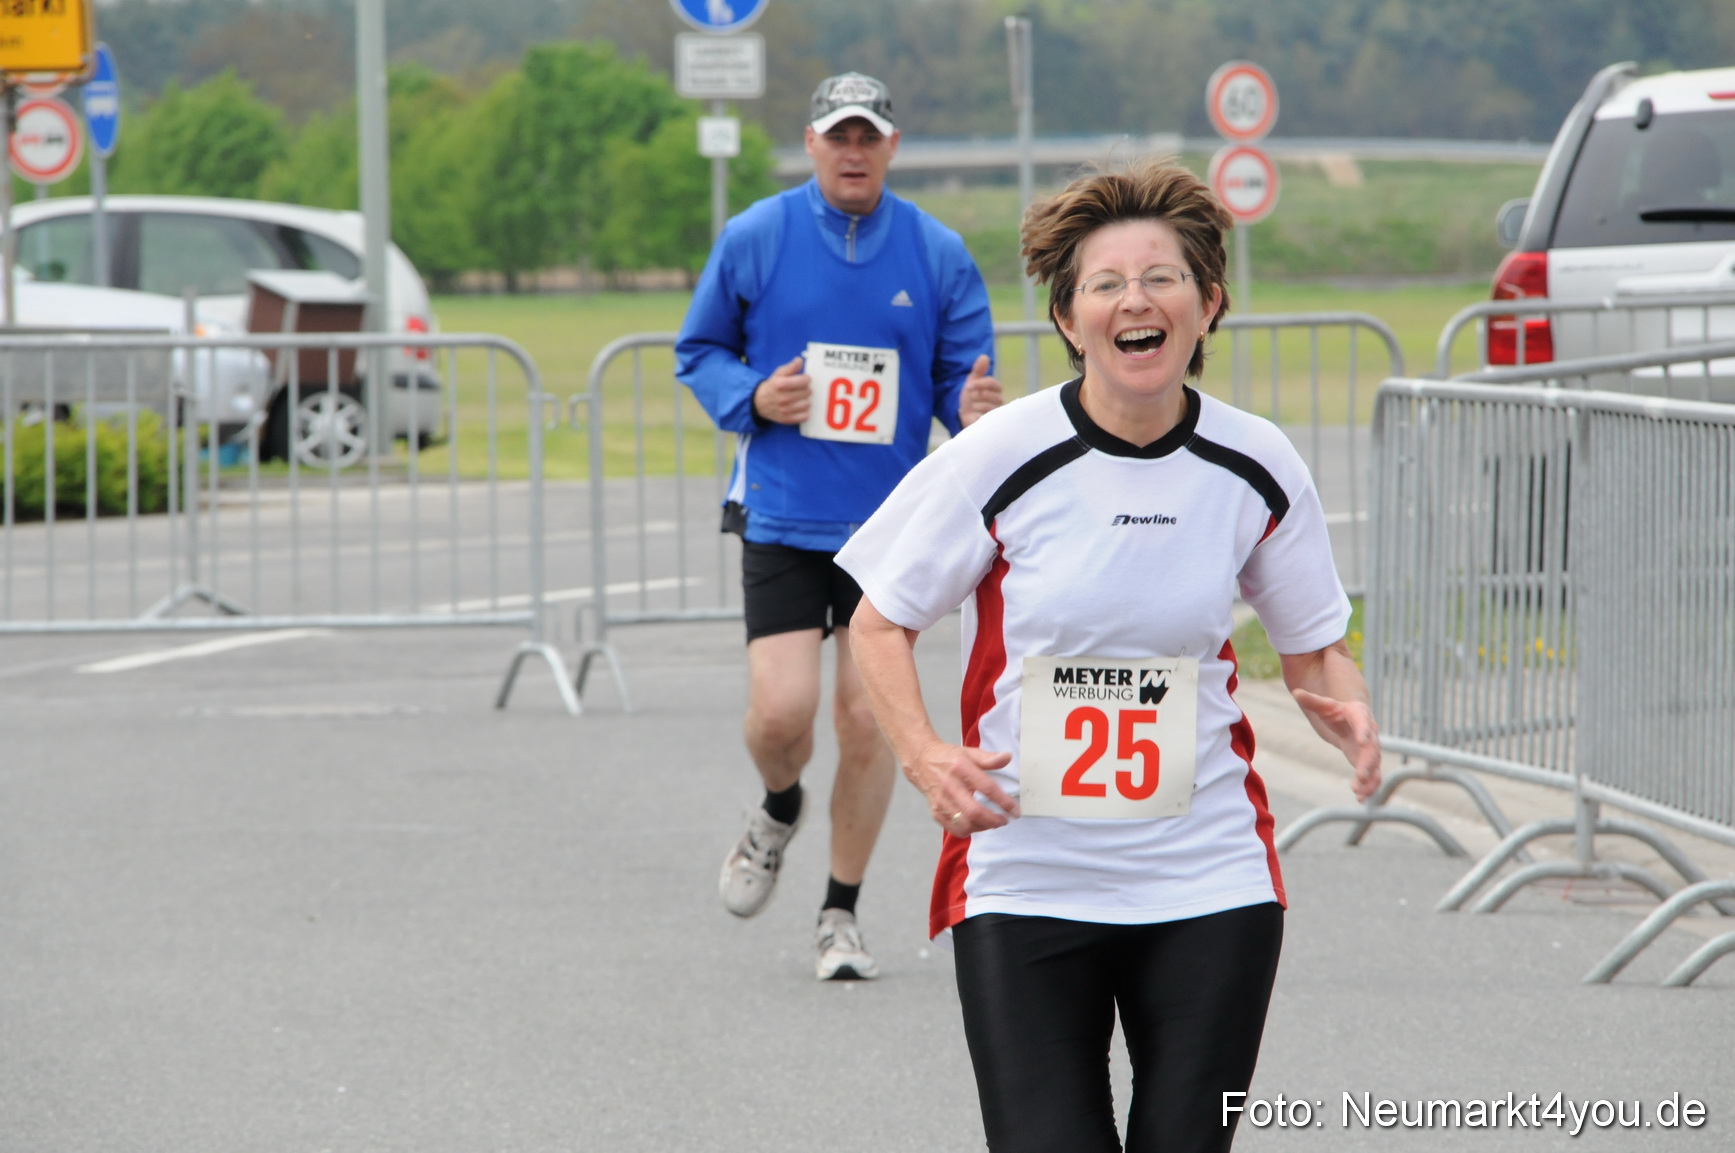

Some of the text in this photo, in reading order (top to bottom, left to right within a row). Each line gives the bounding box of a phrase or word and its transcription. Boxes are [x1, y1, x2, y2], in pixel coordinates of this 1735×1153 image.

[824, 349, 869, 363] MEYER
[826, 376, 881, 433] 62
[1053, 667, 1133, 686] MEYER
[1053, 686, 1134, 701] WERBUNG
[1061, 706, 1160, 801] 25
